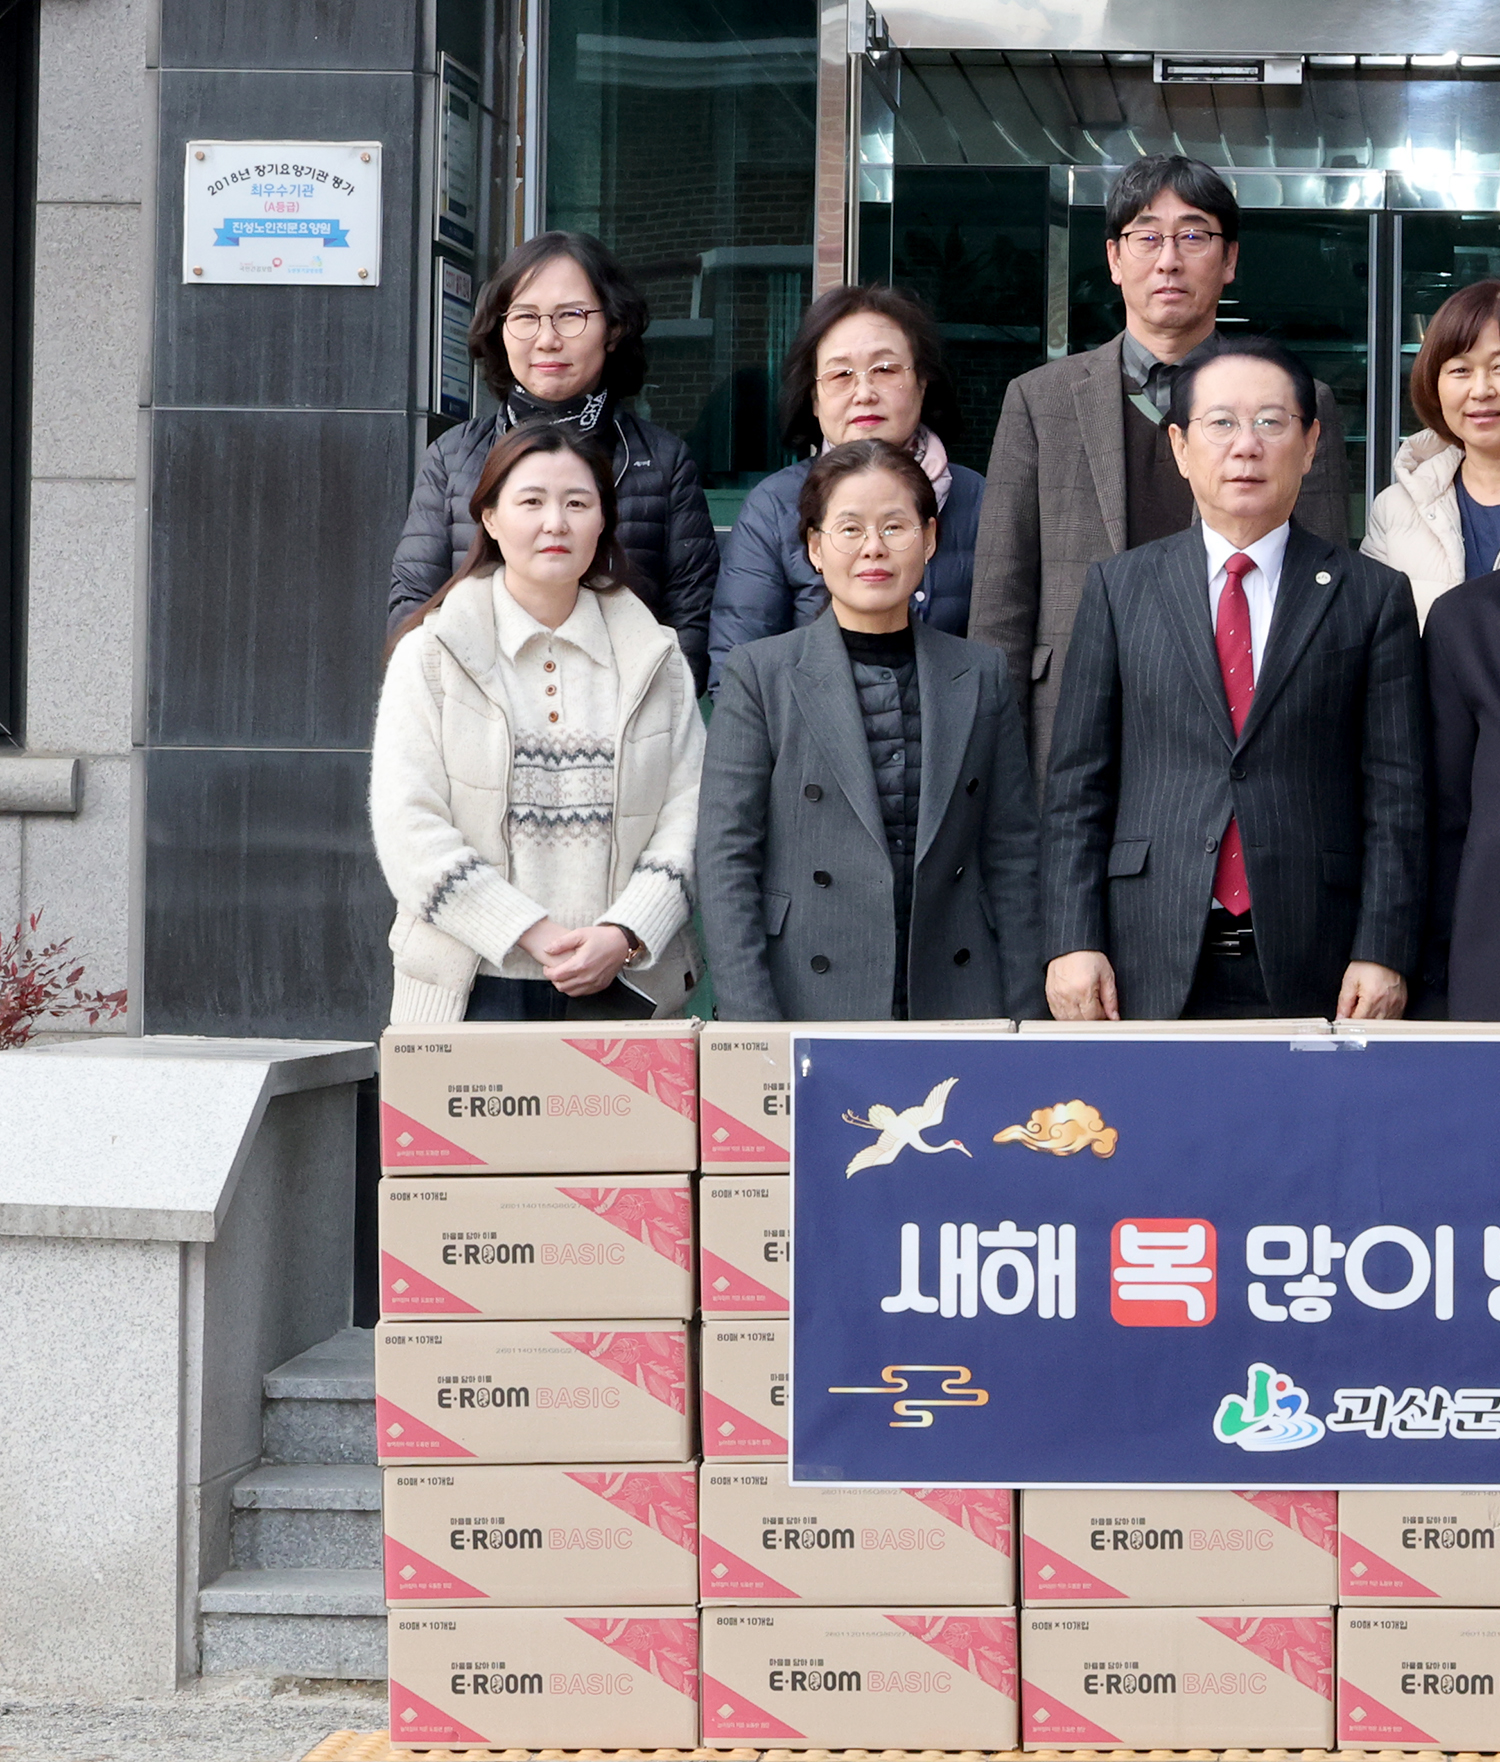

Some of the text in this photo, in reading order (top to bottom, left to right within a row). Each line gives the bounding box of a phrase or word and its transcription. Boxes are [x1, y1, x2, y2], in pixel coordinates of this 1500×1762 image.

[207, 163, 356, 197] 2018년 장기요양기관 평가
[251, 183, 315, 198] 최우수기관
[264, 201, 300, 213] (A등급)
[232, 221, 331, 235] 진성노인전문요양원
[547, 1095, 630, 1117] BASIC
[542, 1243, 625, 1265] BASIC
[880, 1222, 1076, 1320] 새해
[1112, 1225, 1213, 1322] 복
[1245, 1224, 1454, 1322] 많이
[537, 1386, 620, 1408] BASIC
[550, 1528, 633, 1550] BASIC
[862, 1527, 945, 1549] BASIC
[1190, 1528, 1273, 1550] BASIC
[550, 1672, 633, 1694] BASIC
[868, 1669, 951, 1691] BASIC
[1183, 1672, 1266, 1694] BASIC
